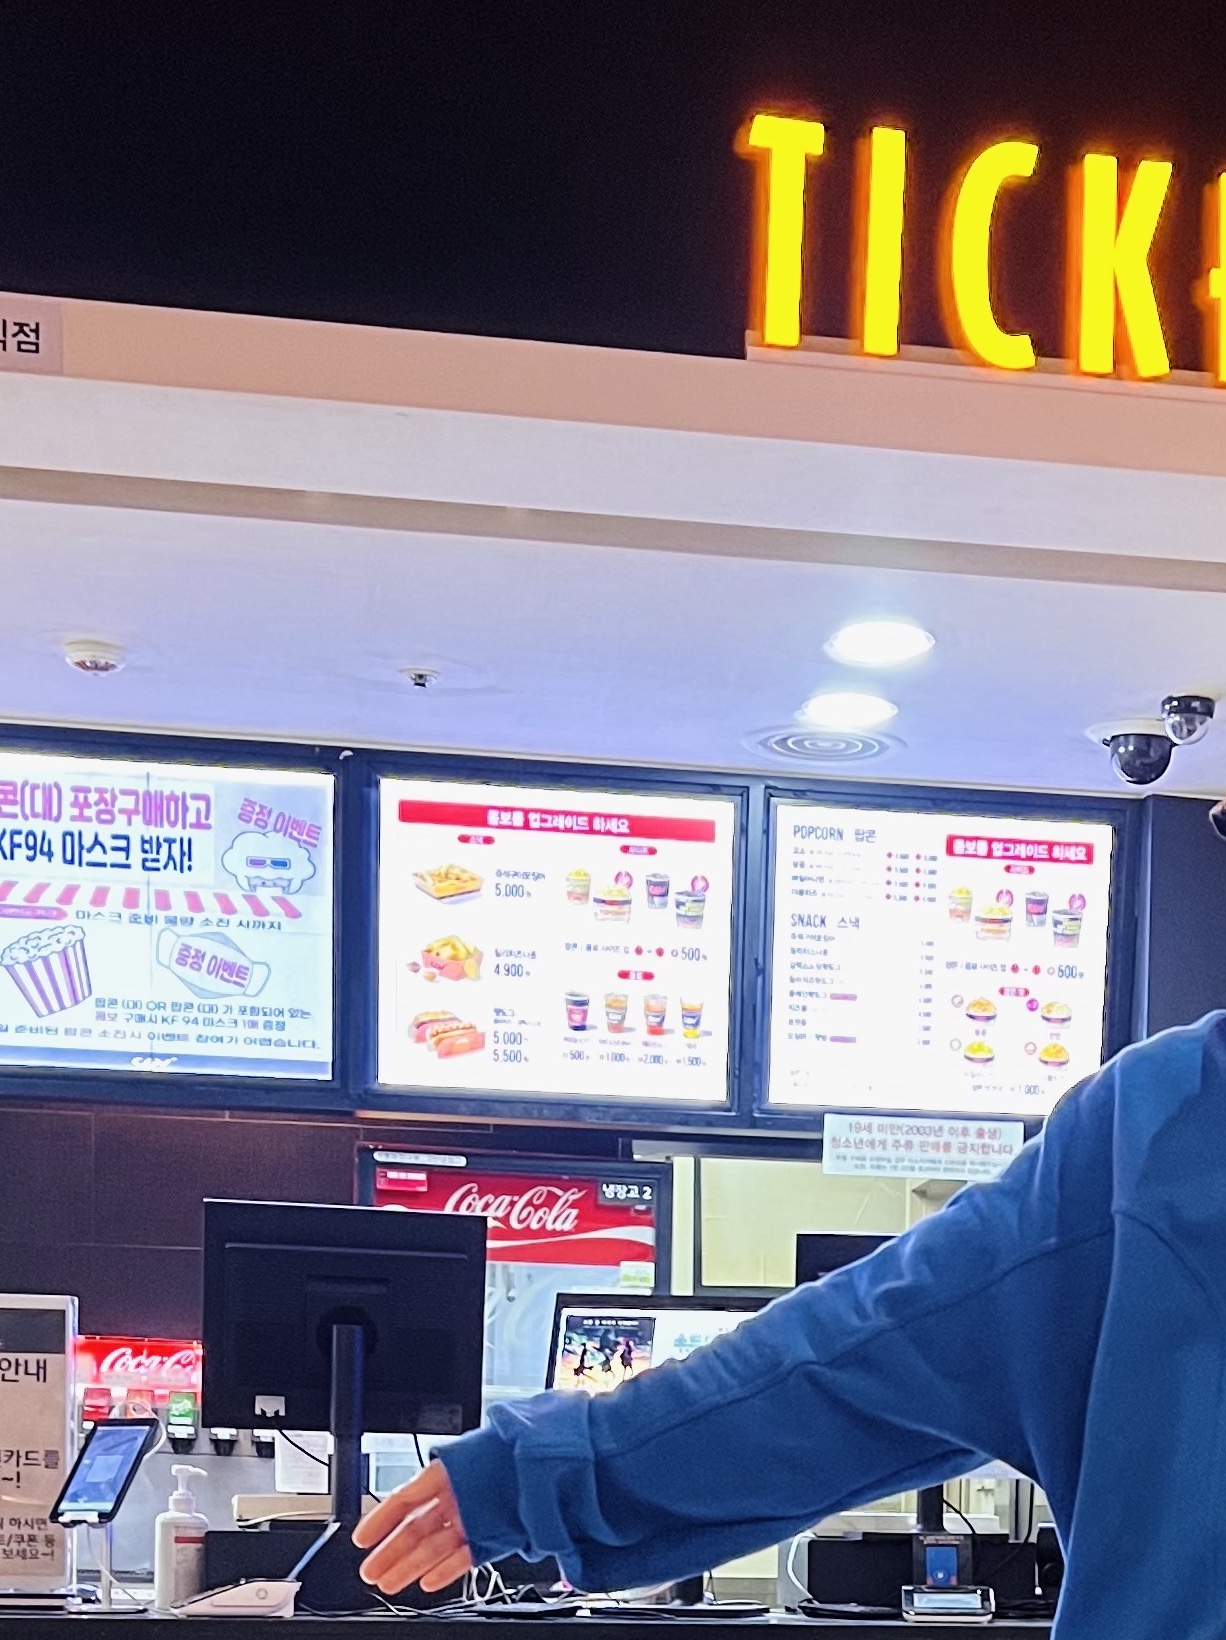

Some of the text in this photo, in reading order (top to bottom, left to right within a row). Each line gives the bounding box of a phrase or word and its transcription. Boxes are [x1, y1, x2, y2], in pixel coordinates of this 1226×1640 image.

[70, 785, 213, 831] 포장구매하고
[238, 797, 323, 848] 증정 이벤트
[793, 824, 877, 843] POPCORN 팝콘
[62, 829, 132, 870] 마스크
[140, 834, 192, 874] 받자!
[75, 910, 122, 922] 마스크
[791, 912, 860, 929] SNACK 스낵
[175, 942, 251, 989] 증정 이벤트
[146, 1000, 167, 1011] OR
[181, 1015, 199, 1026] 94
[642, 1184, 653, 1200] 2
[444, 1182, 589, 1232] Coca-Cola
[0, 1358, 47, 1383] 안내
[0, 1449, 60, 1469] 카드를
